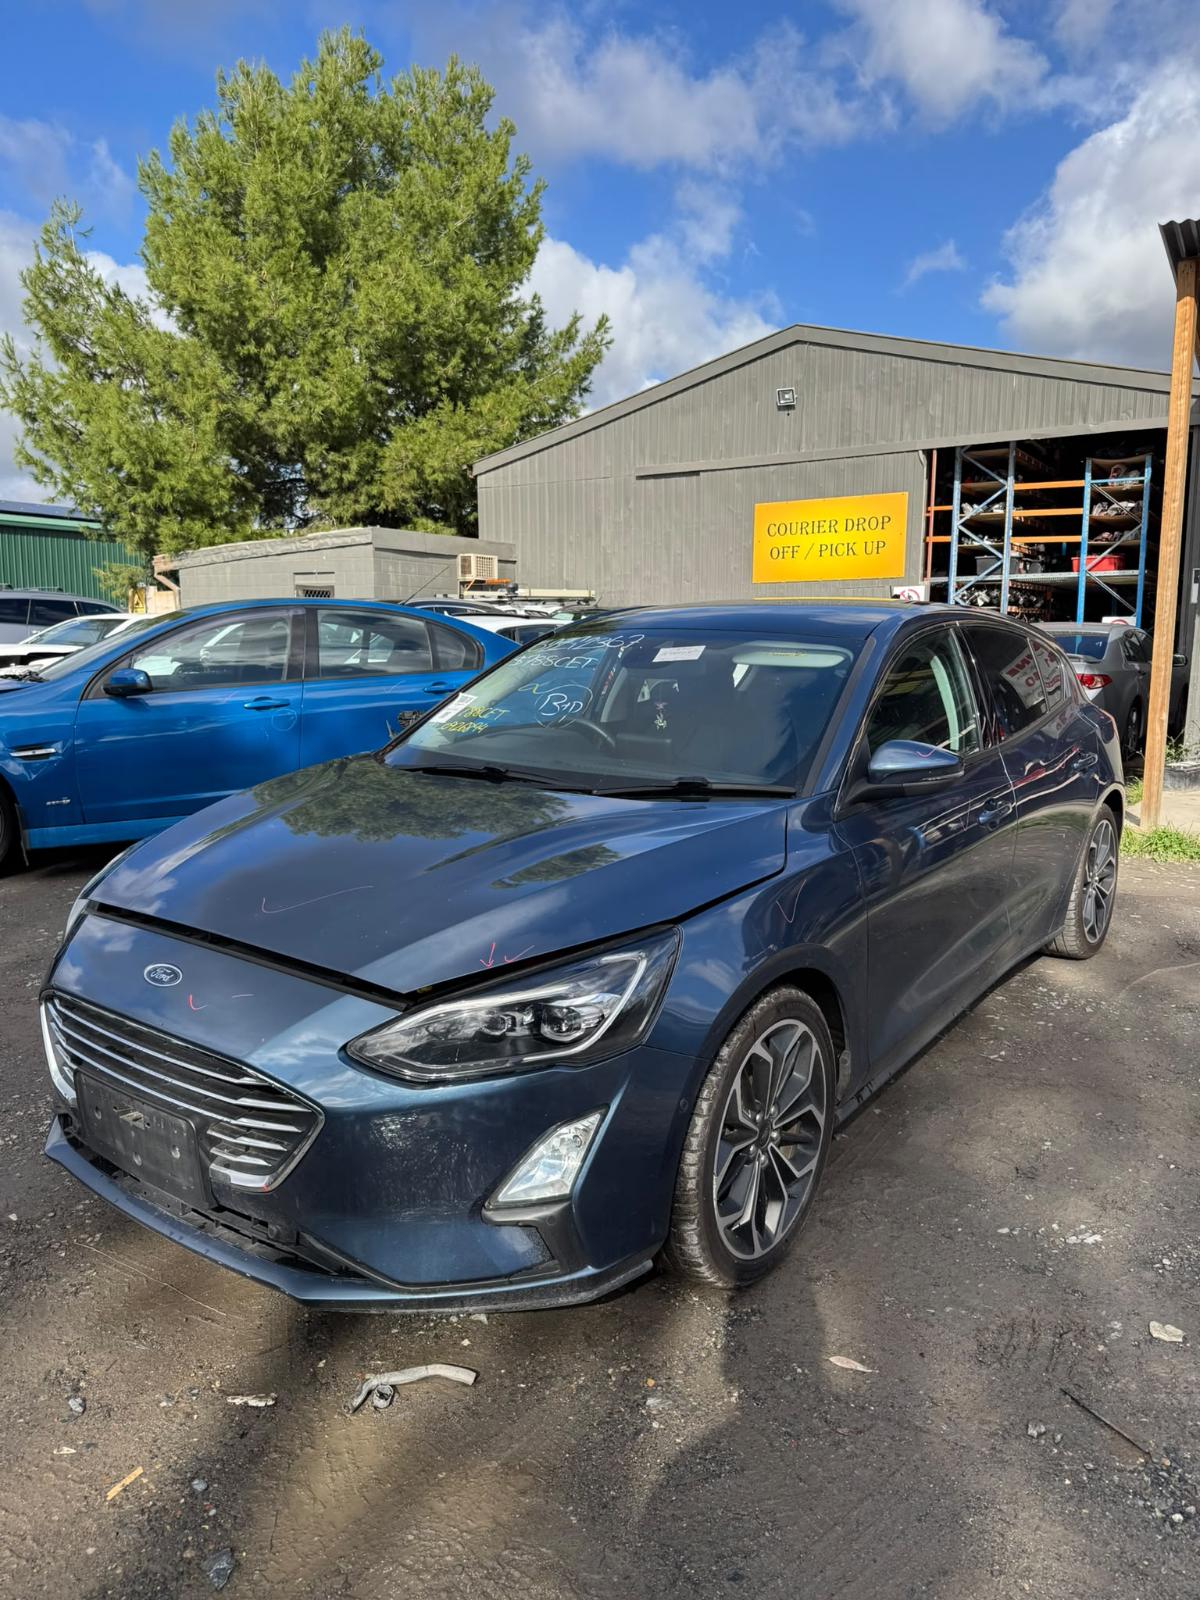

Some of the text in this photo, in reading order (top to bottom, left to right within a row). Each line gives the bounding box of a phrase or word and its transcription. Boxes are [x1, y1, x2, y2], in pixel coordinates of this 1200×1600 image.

[767, 515, 892, 537] COURIER DROP
[769, 540, 886, 560] OFF / PICK UP
